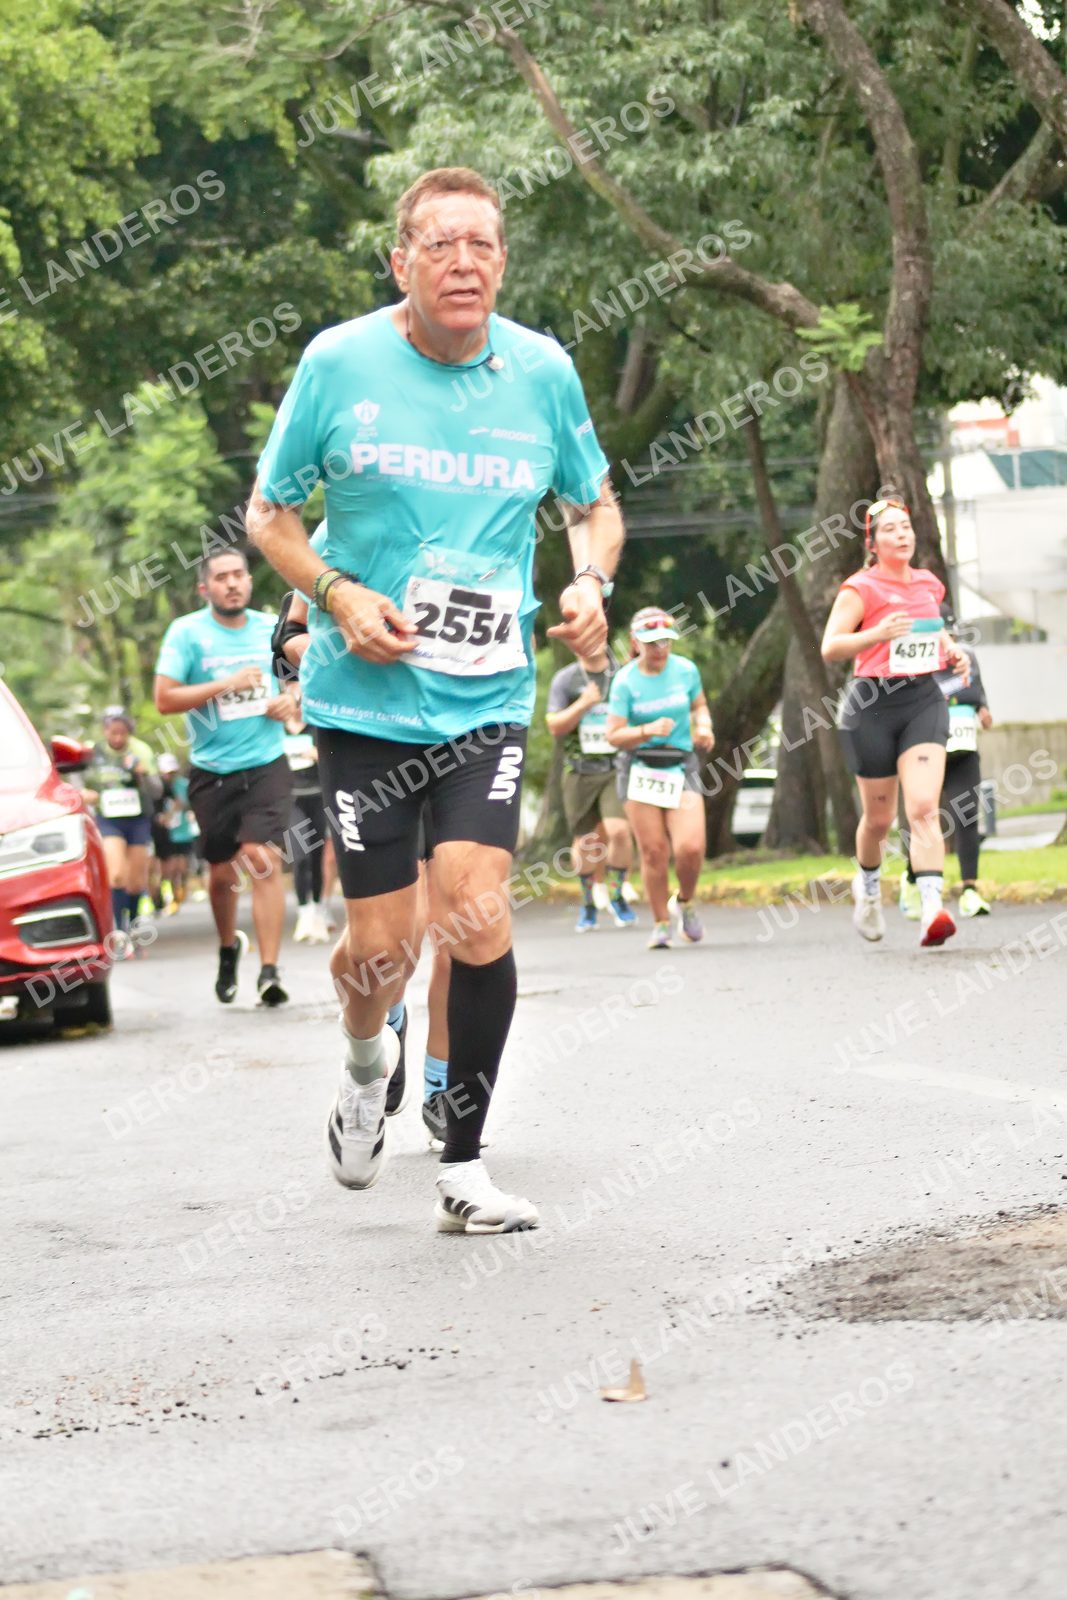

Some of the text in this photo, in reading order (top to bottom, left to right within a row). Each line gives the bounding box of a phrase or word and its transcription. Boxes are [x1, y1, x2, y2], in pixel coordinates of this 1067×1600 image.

[491, 427, 537, 443] BROOKS
[350, 443, 536, 490] PERDURA
[413, 602, 513, 646] 2554
[895, 641, 936, 658] 4872
[636, 776, 675, 795] 3731
